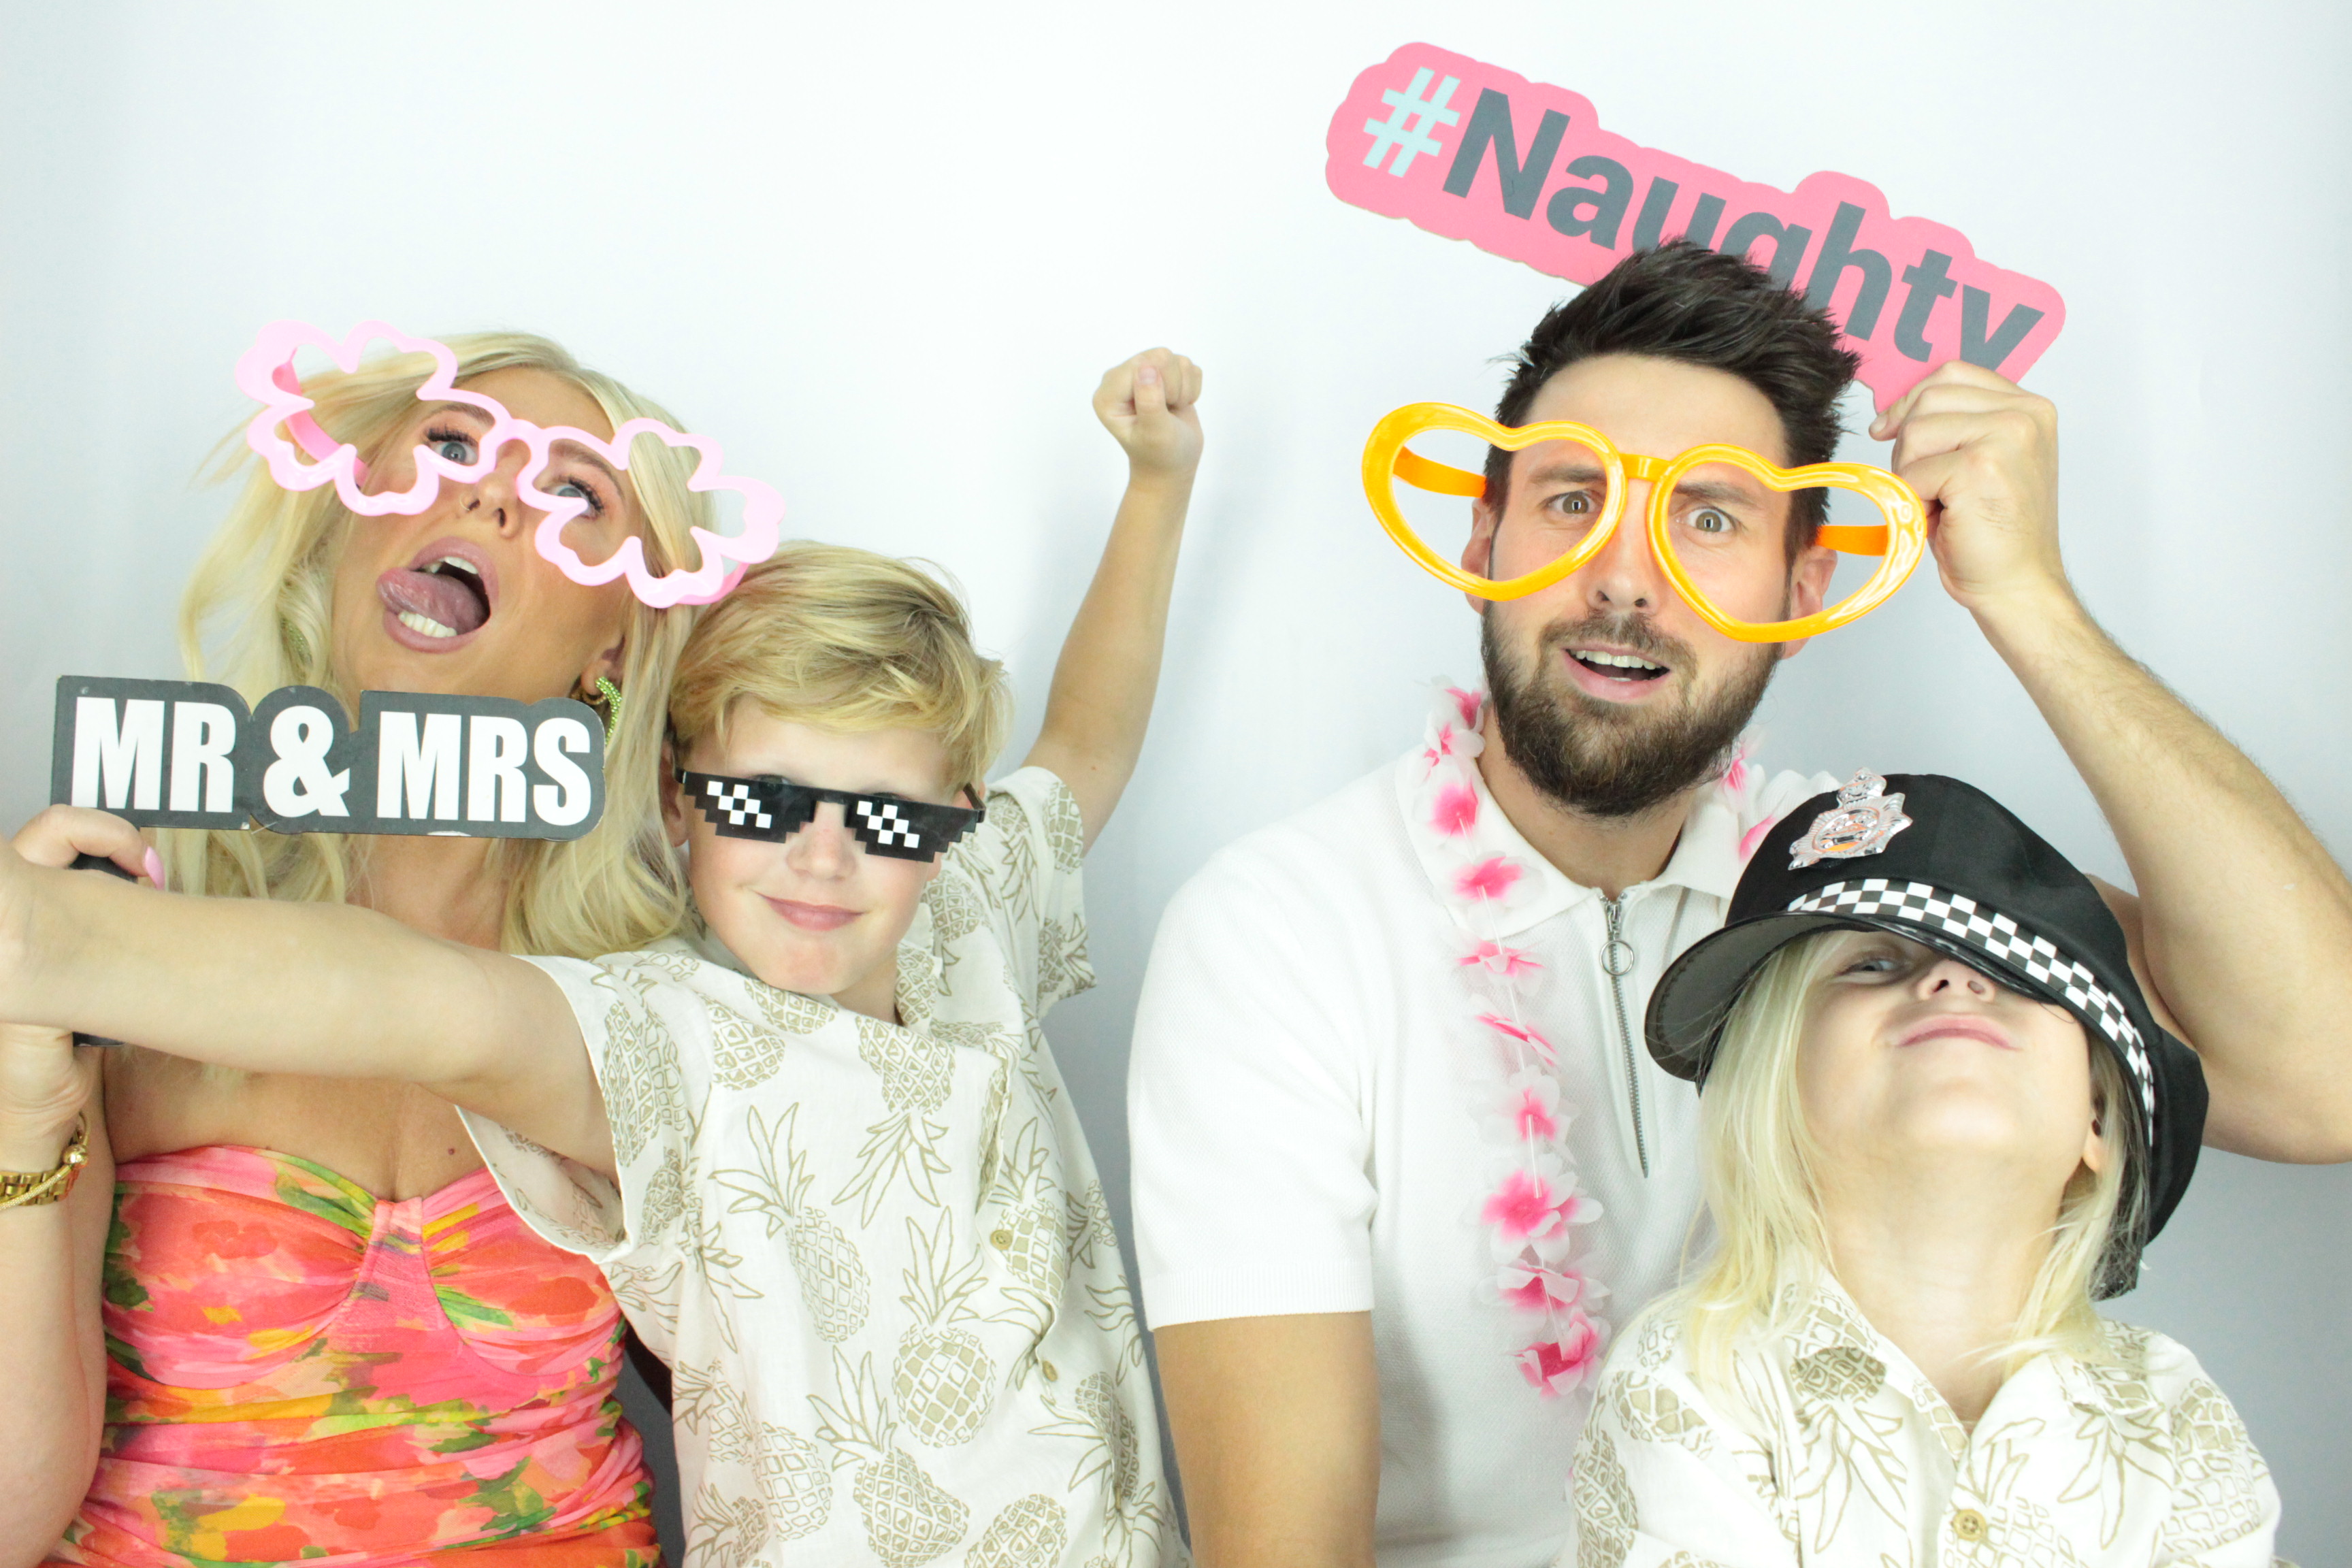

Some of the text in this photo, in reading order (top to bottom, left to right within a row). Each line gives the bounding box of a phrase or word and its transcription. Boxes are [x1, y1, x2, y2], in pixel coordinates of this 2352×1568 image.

[71, 696, 591, 826] MR & MRS
